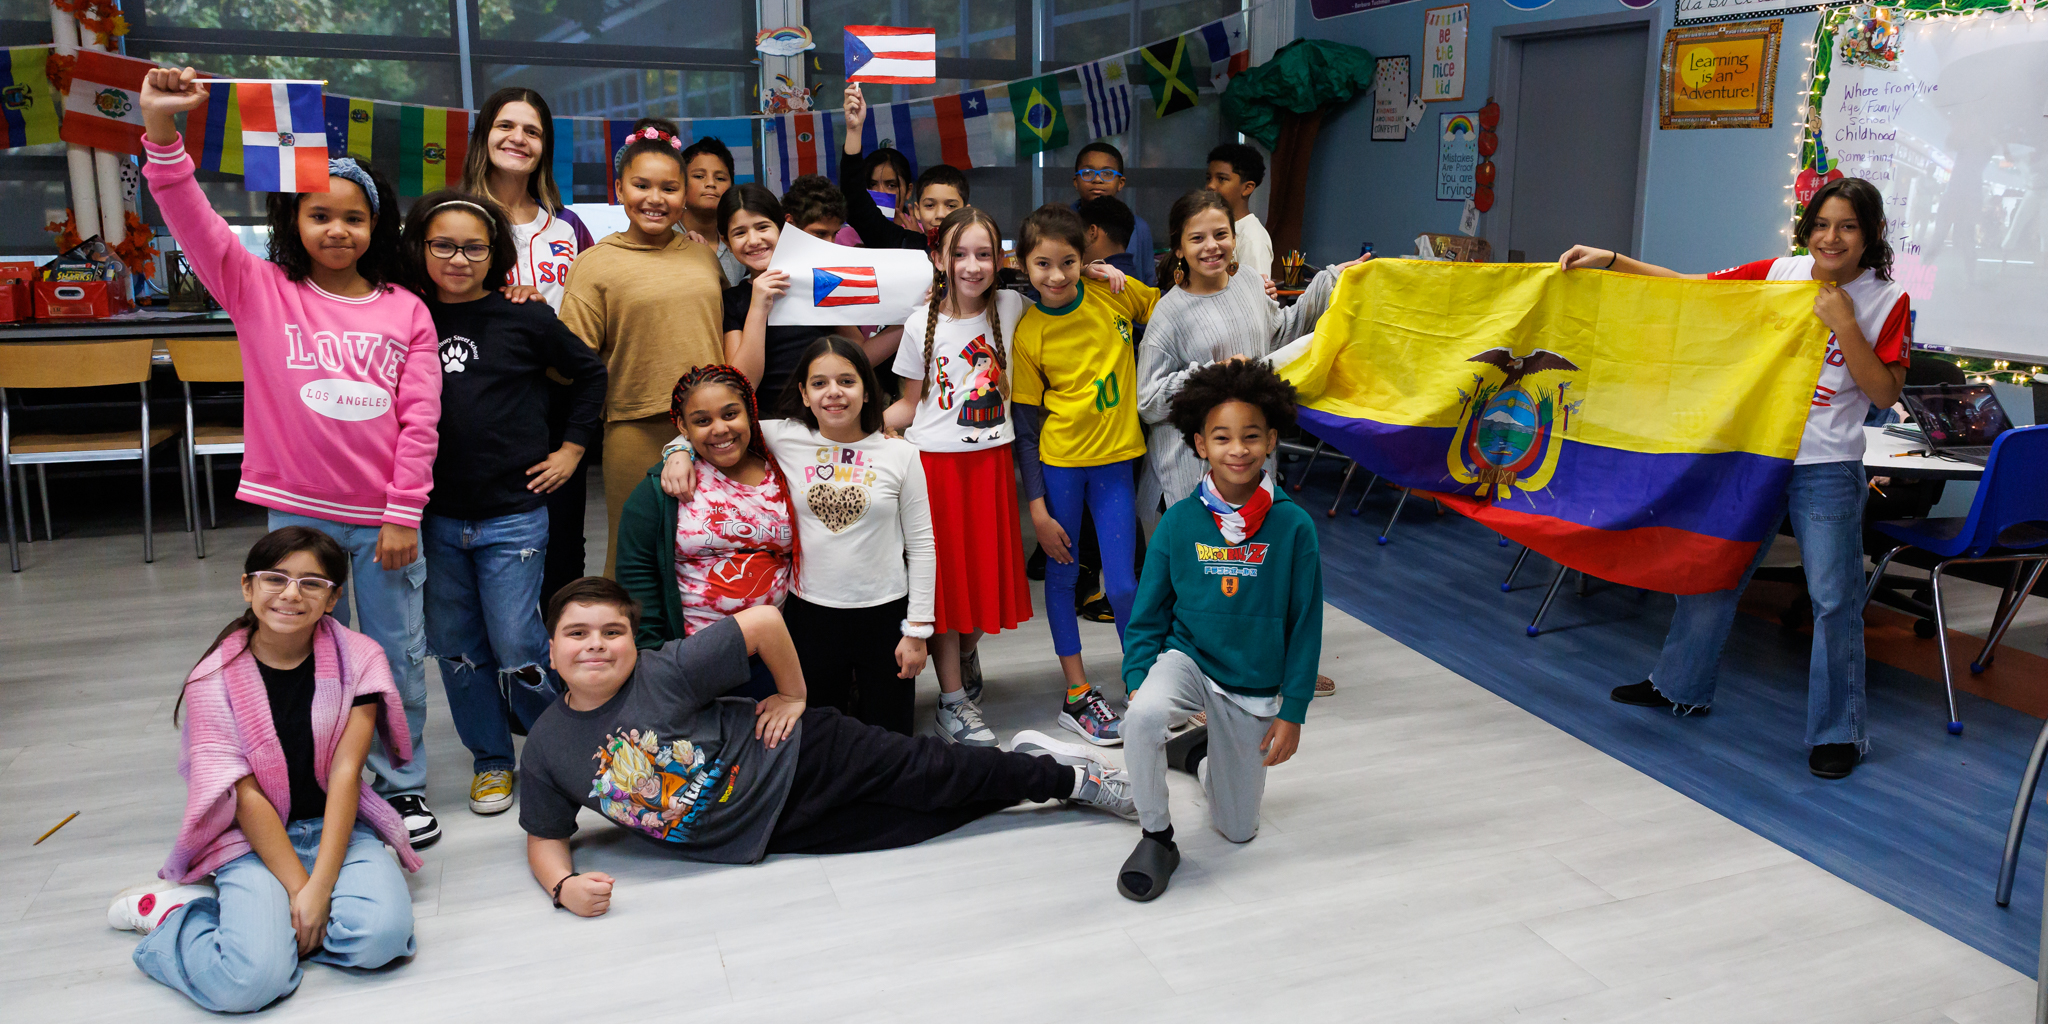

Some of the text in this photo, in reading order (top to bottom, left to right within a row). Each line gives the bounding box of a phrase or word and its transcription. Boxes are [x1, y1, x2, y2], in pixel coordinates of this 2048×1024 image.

[1436, 45, 1453, 61] the
[1432, 62, 1455, 78] nice
[1689, 51, 1750, 74] Learning
[1701, 70, 1733, 83] is an
[1435, 80, 1451, 95] kid
[1678, 81, 1755, 100] Adventure!
[1844, 82, 1879, 100] Where
[1849, 115, 1891, 125] School
[1374, 124, 1400, 134] CONFETTI
[1835, 125, 1896, 141] Childhood
[1442, 153, 1474, 162] Mistakes
[1838, 149, 1893, 167] Something
[1442, 162, 1474, 171] Are Proof
[1441, 172, 1473, 182] You are
[56, 271, 94, 282] SHARKS!
[284, 323, 410, 389] LOVE
[306, 388, 388, 408] LOS ANGELES
[1093, 370, 1121, 413] 10
[815, 445, 865, 467] GIRL
[804, 463, 877, 487] POWER
[702, 517, 793, 545] STONE
